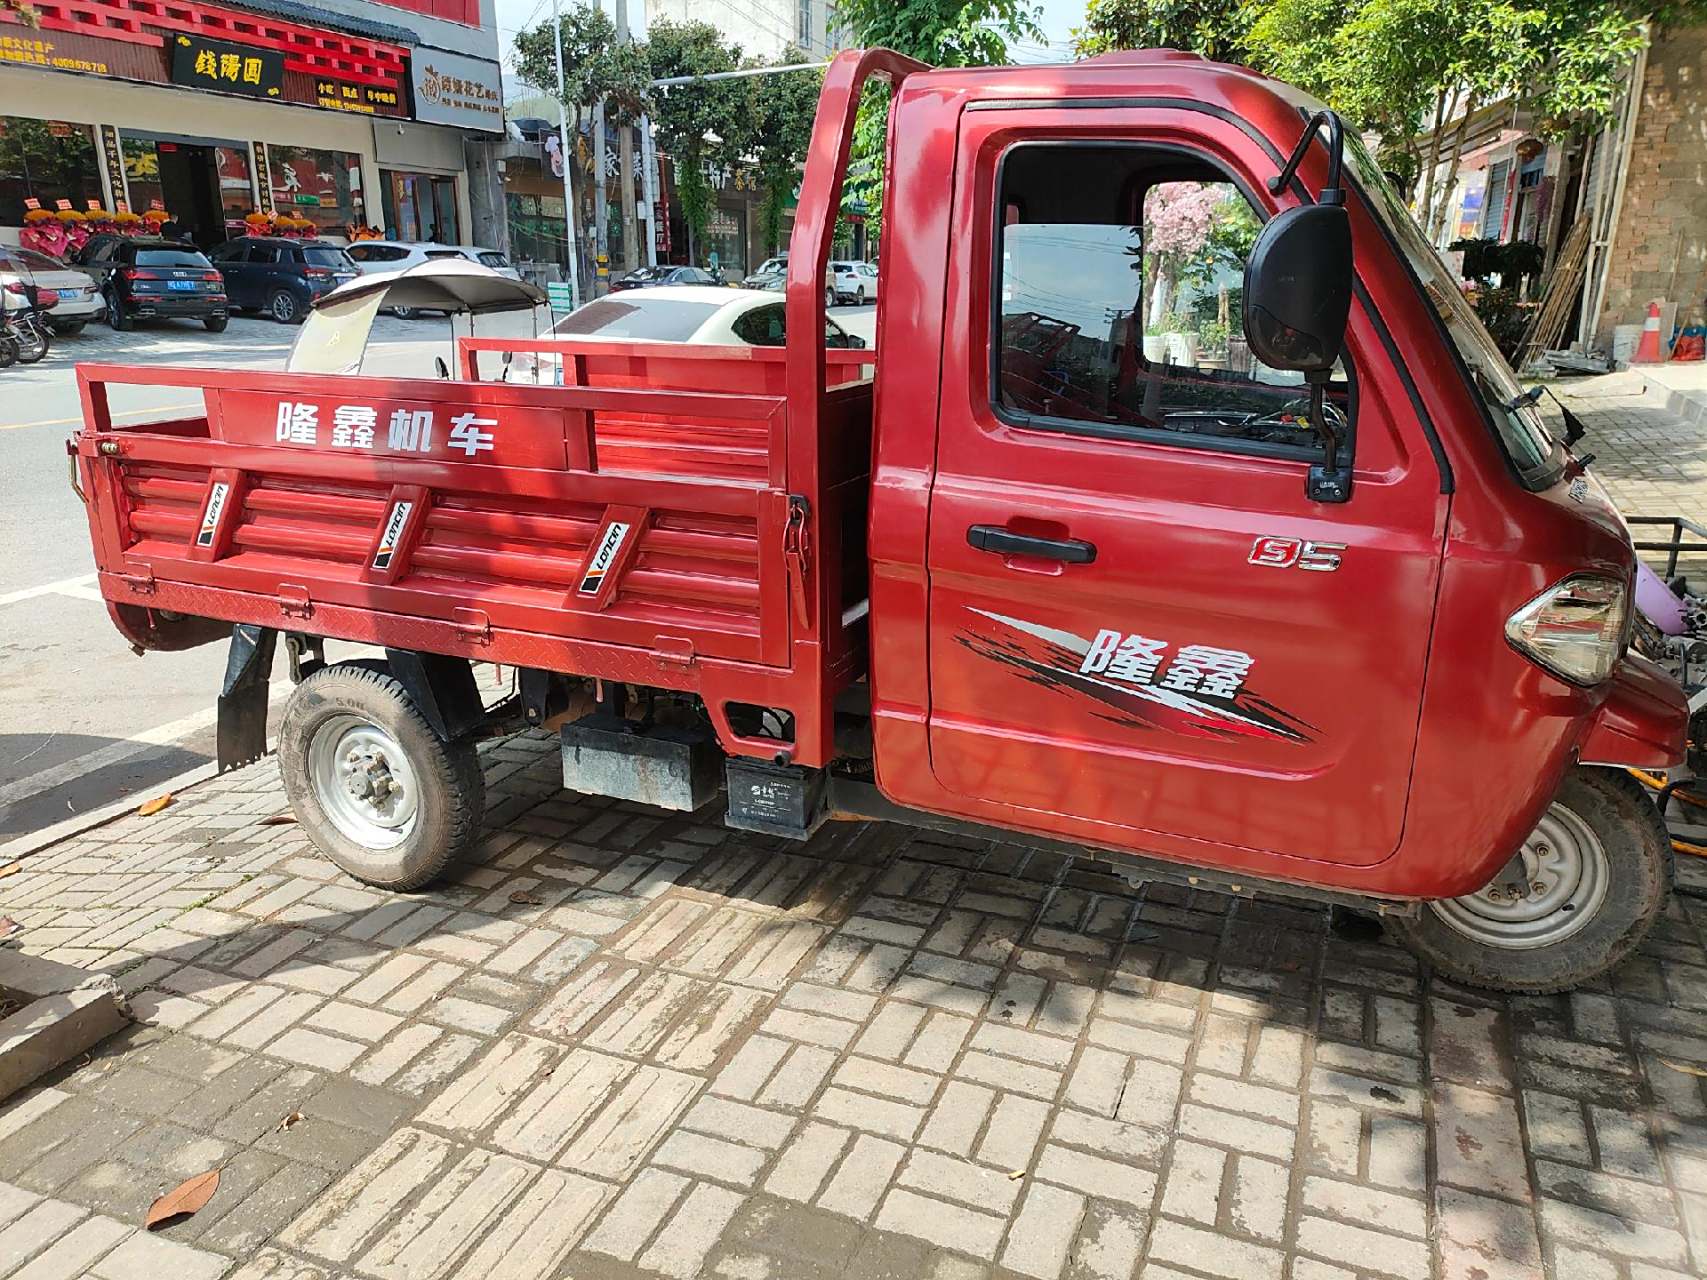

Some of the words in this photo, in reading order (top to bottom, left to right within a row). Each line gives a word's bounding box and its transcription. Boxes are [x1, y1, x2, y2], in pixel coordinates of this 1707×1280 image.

[275, 401, 499, 456] 隆鑫机车
[1079, 628, 1256, 699] 隆鑫
